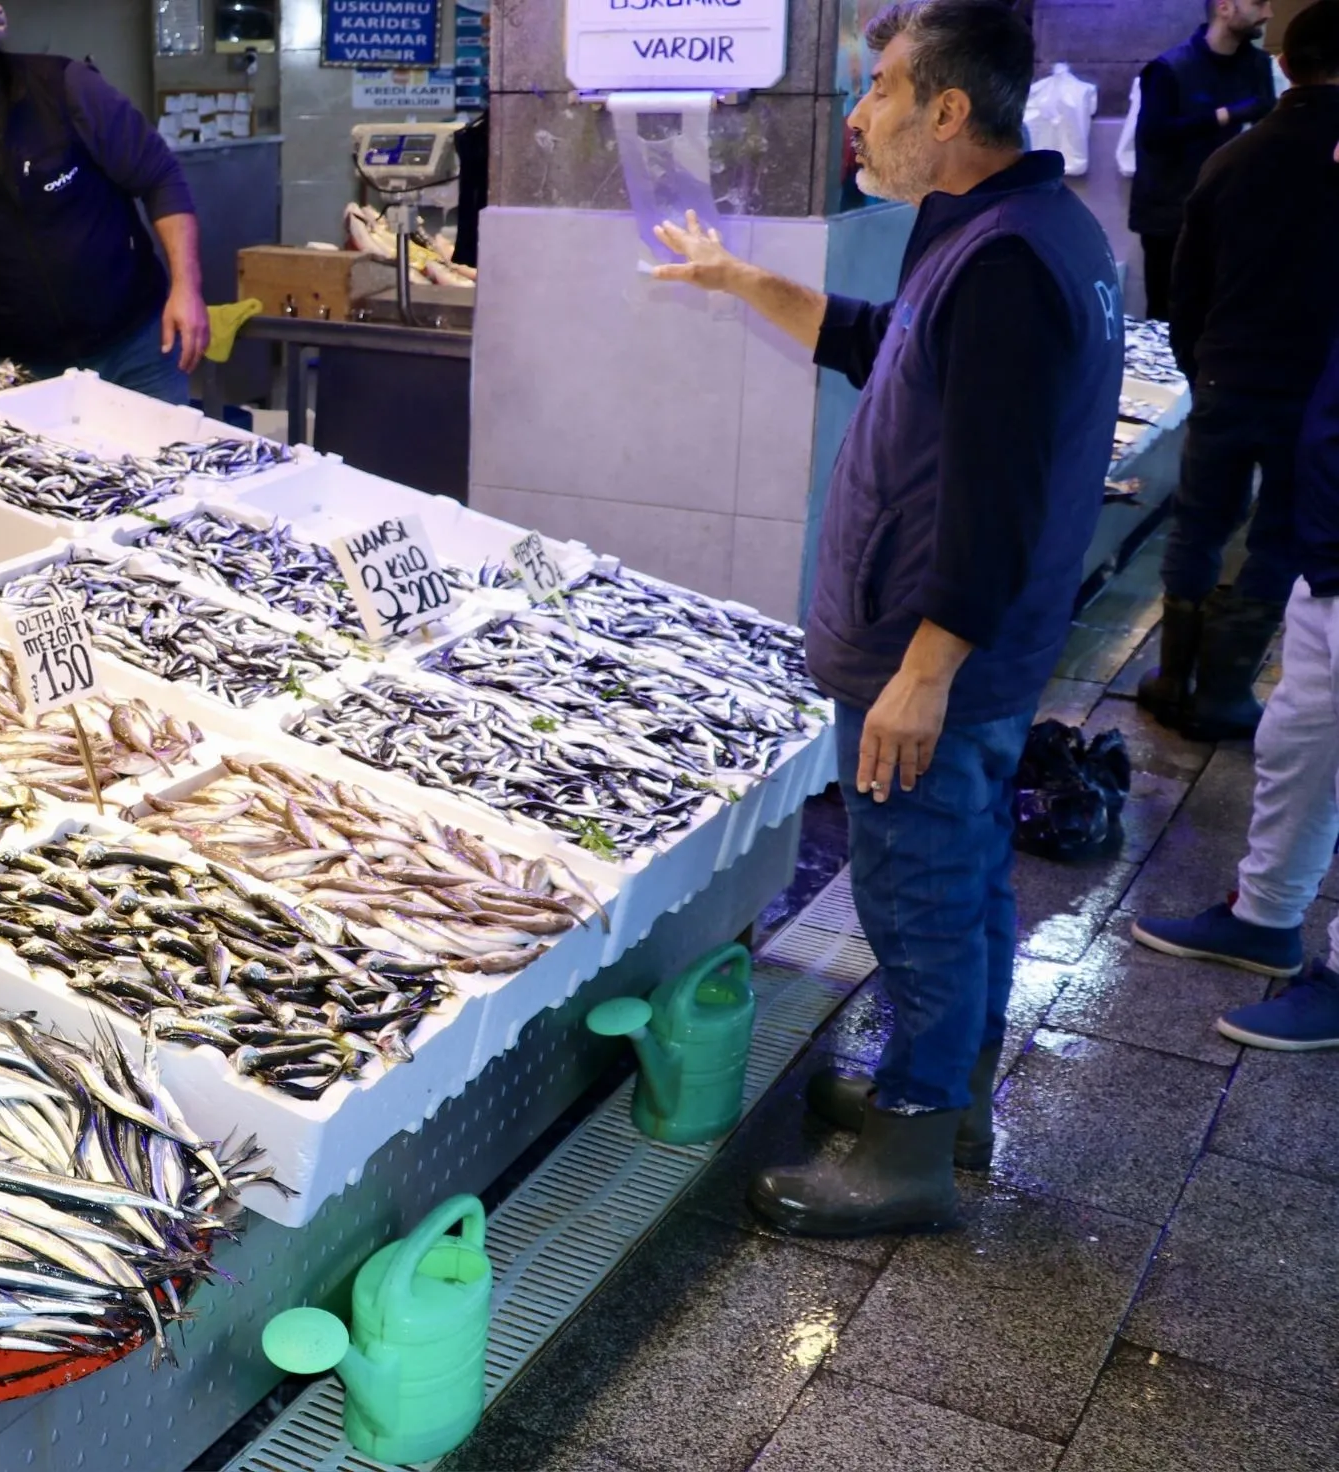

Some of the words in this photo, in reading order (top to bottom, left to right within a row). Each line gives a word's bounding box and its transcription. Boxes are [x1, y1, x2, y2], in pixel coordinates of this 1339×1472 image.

[341, 15, 421, 30] KARİDES
[334, 32, 427, 46] KALAMAR
[633, 36, 734, 63] VARDIR
[16, 609, 55, 636] OLTA
[39, 643, 94, 701] 150
